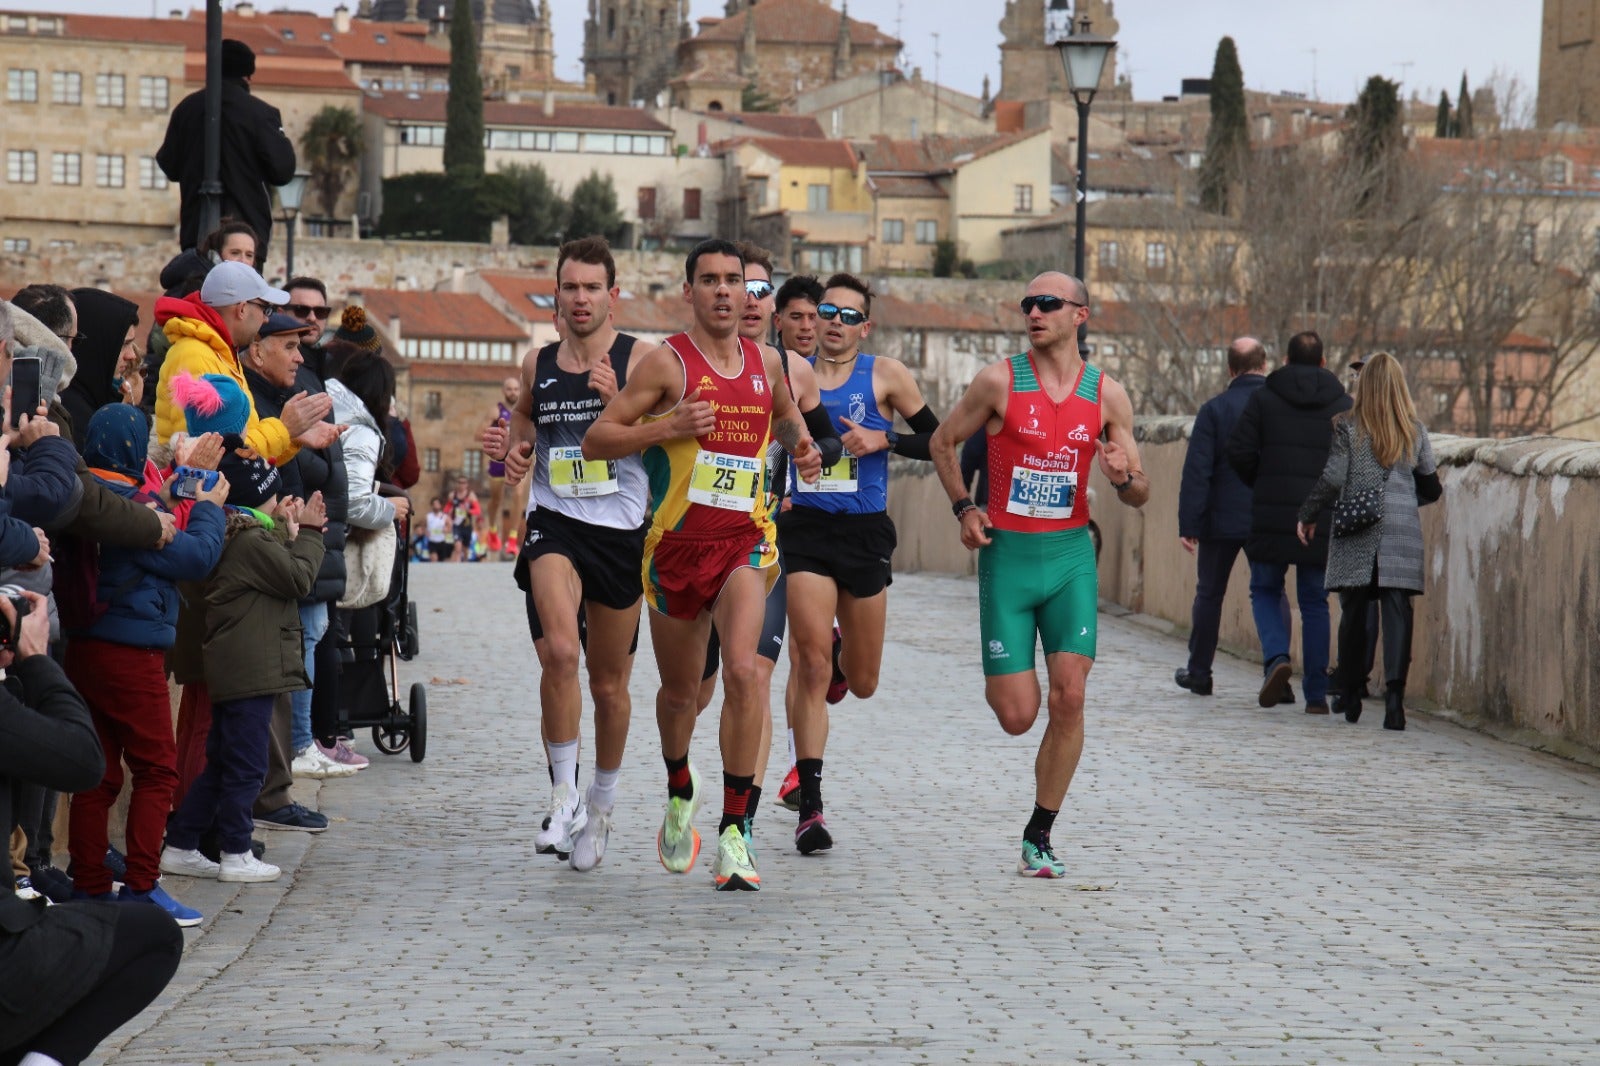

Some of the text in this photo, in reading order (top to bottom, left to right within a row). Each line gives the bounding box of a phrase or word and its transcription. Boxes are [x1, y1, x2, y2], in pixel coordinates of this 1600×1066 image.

[539, 399, 605, 411] CLUB ATLETISM
[721, 405, 766, 414] CAJA RURAL
[720, 420, 750, 431] VINO
[708, 431, 758, 442] DE TORO
[1023, 454, 1070, 470] Hispana
[1047, 451, 1071, 461] Patria
[572, 460, 584, 479] 11
[715, 456, 757, 470] SETEL
[257, 466, 278, 494] MERRY
[712, 468, 737, 490] 25
[1030, 472, 1072, 484] SETEL
[1018, 481, 1062, 504] 3395
